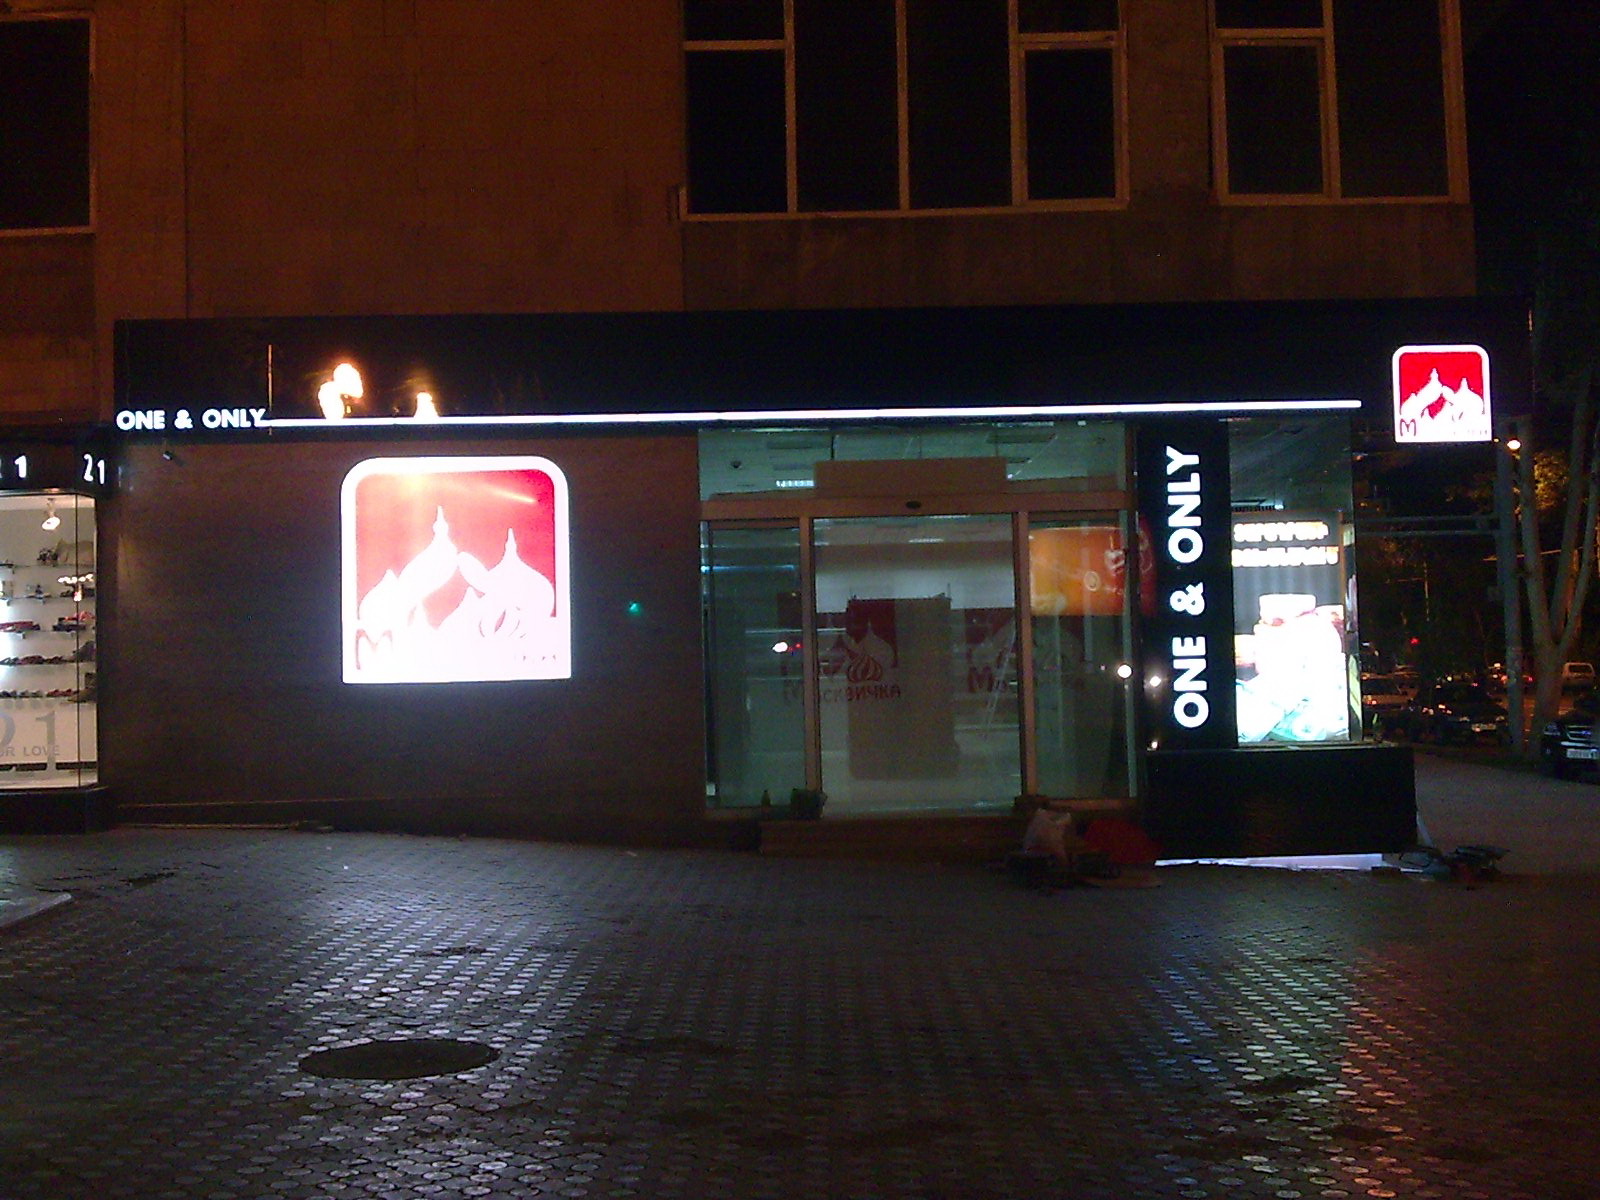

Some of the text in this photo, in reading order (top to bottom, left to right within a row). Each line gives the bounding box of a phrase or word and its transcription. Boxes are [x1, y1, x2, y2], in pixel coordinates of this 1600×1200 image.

[116, 408, 267, 431] ONE & ONLY
[83, 454, 105, 485] 21
[1165, 445, 1209, 729] ONE & ONLY
